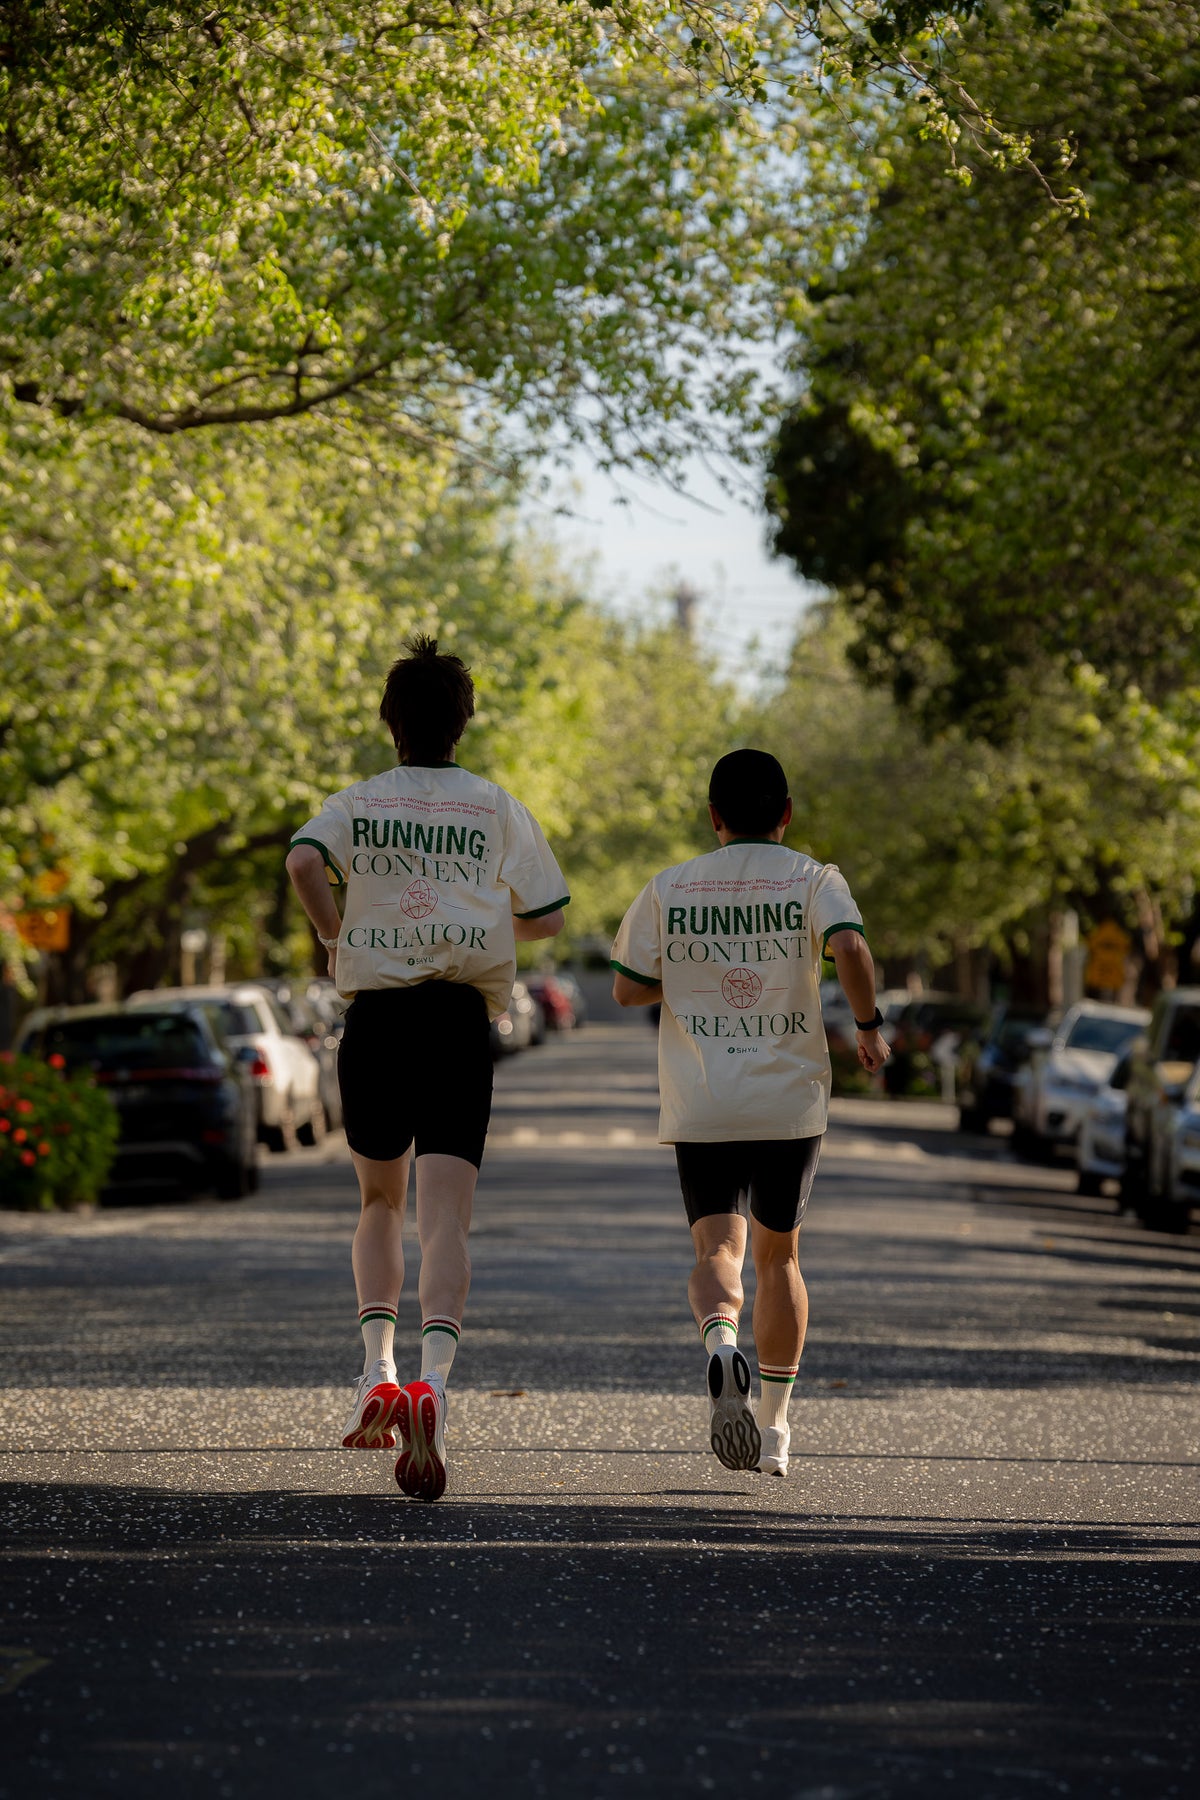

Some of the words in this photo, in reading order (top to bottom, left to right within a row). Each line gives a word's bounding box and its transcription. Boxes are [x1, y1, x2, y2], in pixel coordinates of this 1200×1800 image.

[462, 809, 480, 817] SPACE
[470, 803, 496, 815] PURPOSE
[352, 817, 490, 863] RUNNING:
[352, 853, 487, 887] CONTENT
[667, 900, 807, 936] RUNNING:
[347, 923, 488, 950] CREATOR
[667, 937, 807, 963] CONTENT
[736, 1046, 758, 1054] SHYU
